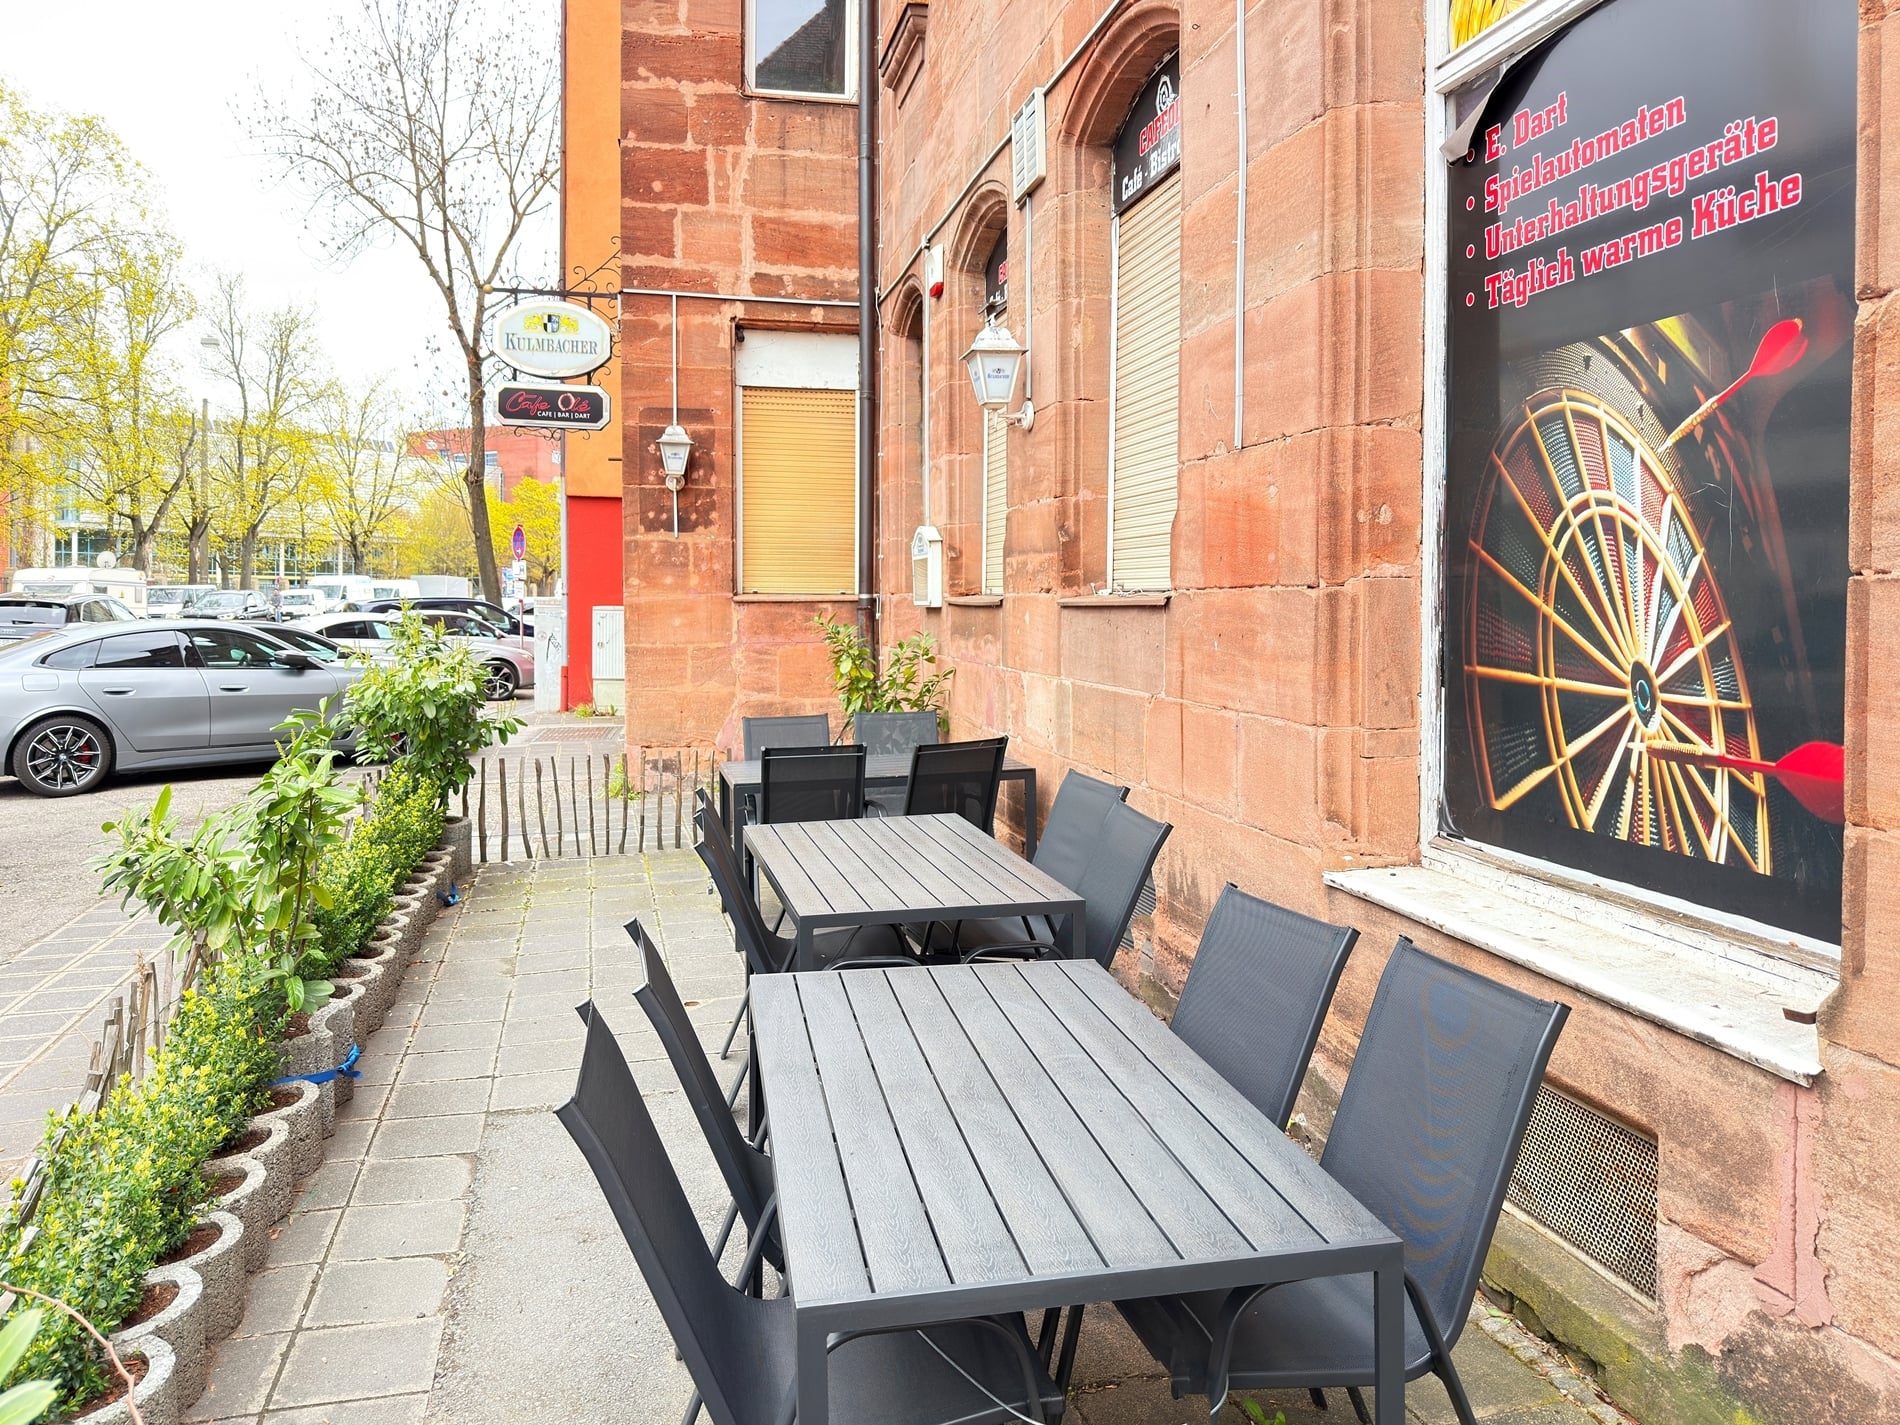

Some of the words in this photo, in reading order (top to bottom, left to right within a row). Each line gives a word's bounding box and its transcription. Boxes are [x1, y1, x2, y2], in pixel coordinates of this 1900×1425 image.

[1484, 123, 1507, 164] E.
[1513, 91, 1568, 149] Dart
[1484, 95, 1687, 215] Spielautomaten
[1122, 164, 1143, 202] Café
[1484, 115, 1779, 261] Unterhaltungsgeräte
[1484, 249, 1575, 310] Täglich
[1581, 216, 1683, 278] warme
[1691, 171, 1802, 241] Küche
[506, 333, 597, 355] KULMBACHER
